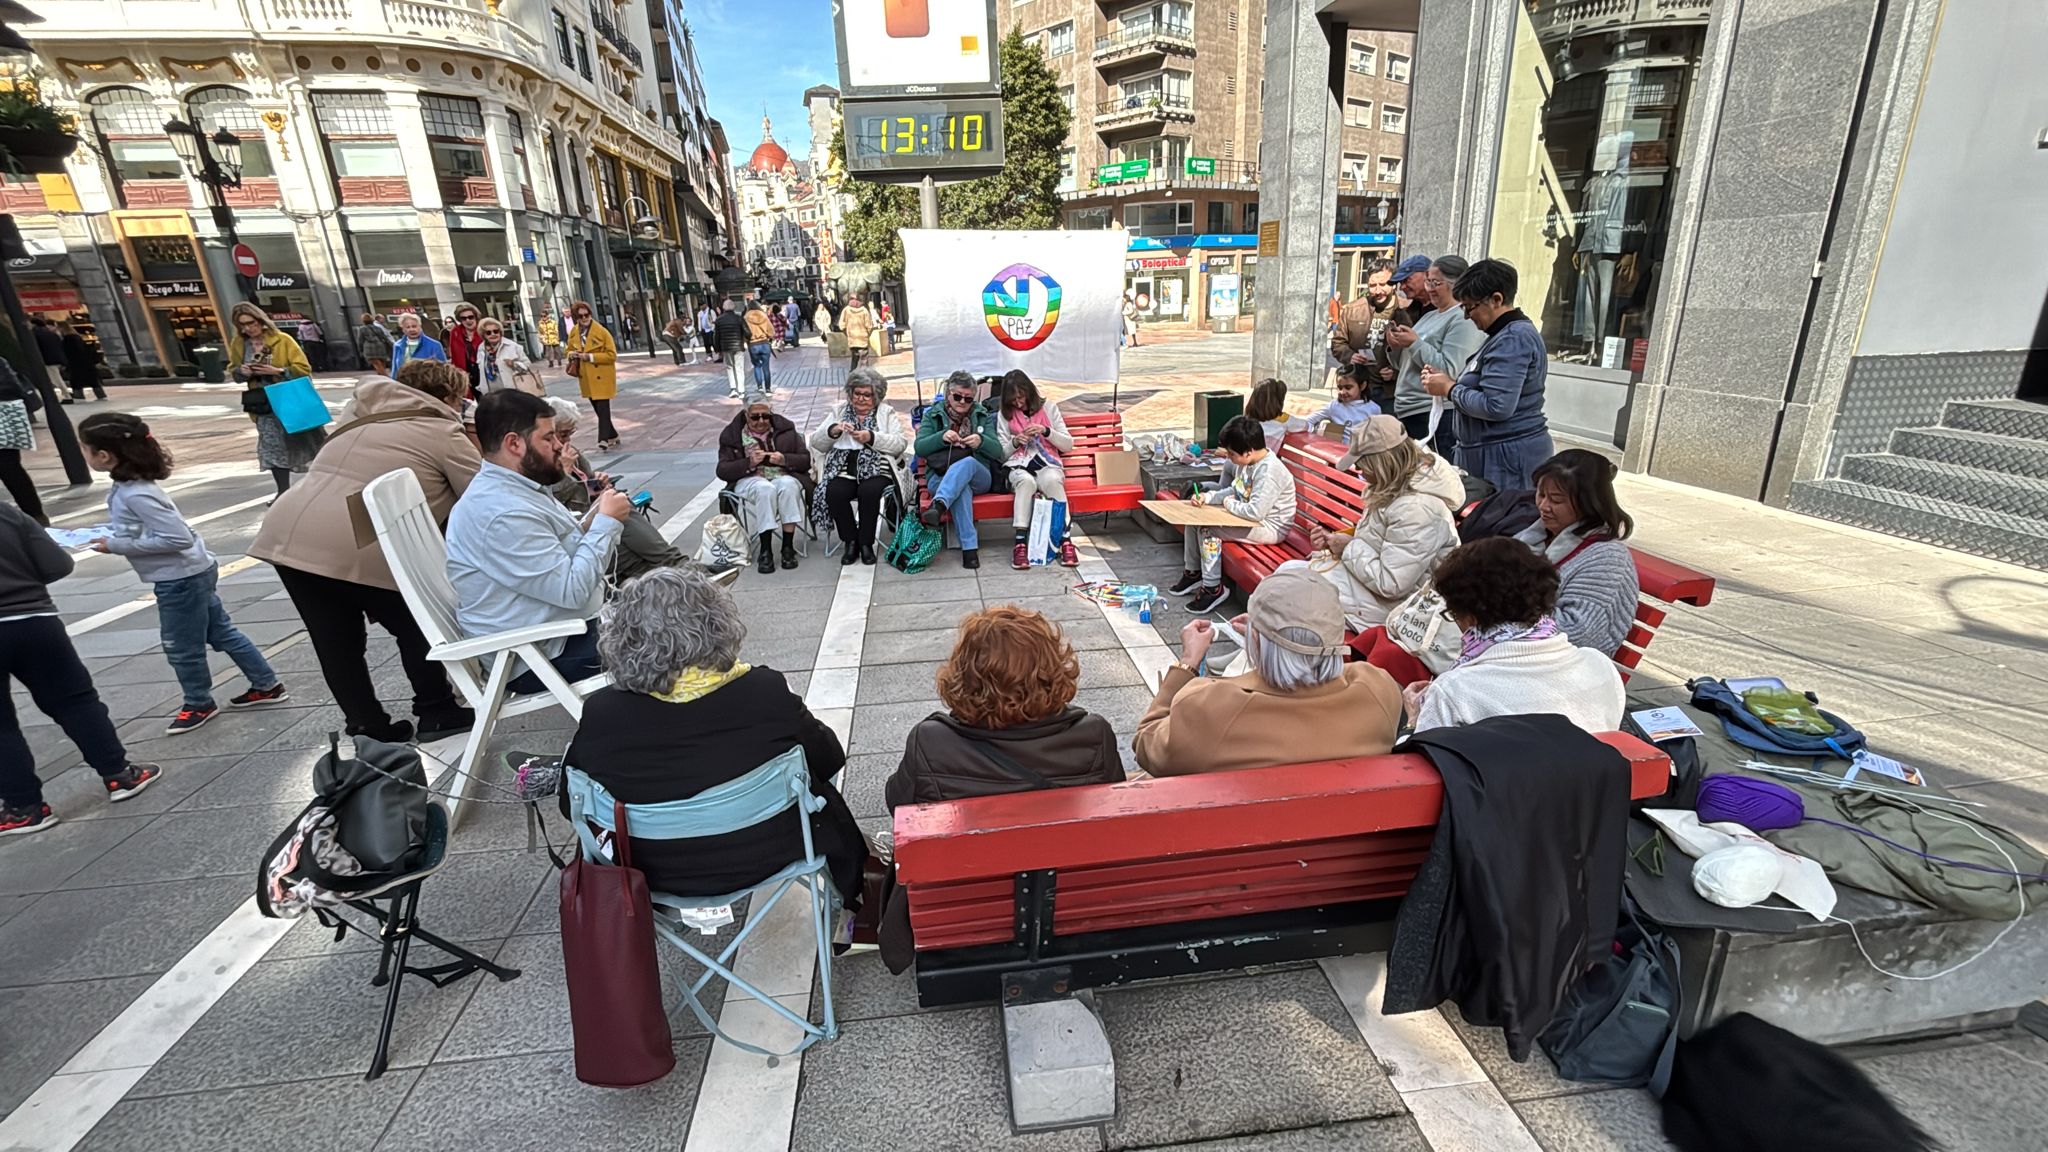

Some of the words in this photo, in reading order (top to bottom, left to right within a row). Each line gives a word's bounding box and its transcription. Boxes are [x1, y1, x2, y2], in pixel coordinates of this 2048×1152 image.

[905, 85, 937, 93] JCDecaux
[880, 114, 983, 153] 13:10
[1142, 256, 1187, 268] Soloptical
[147, 283, 172, 296] Diego
[1007, 317, 1034, 336] PAZ
[1400, 624, 1440, 653] botoes
